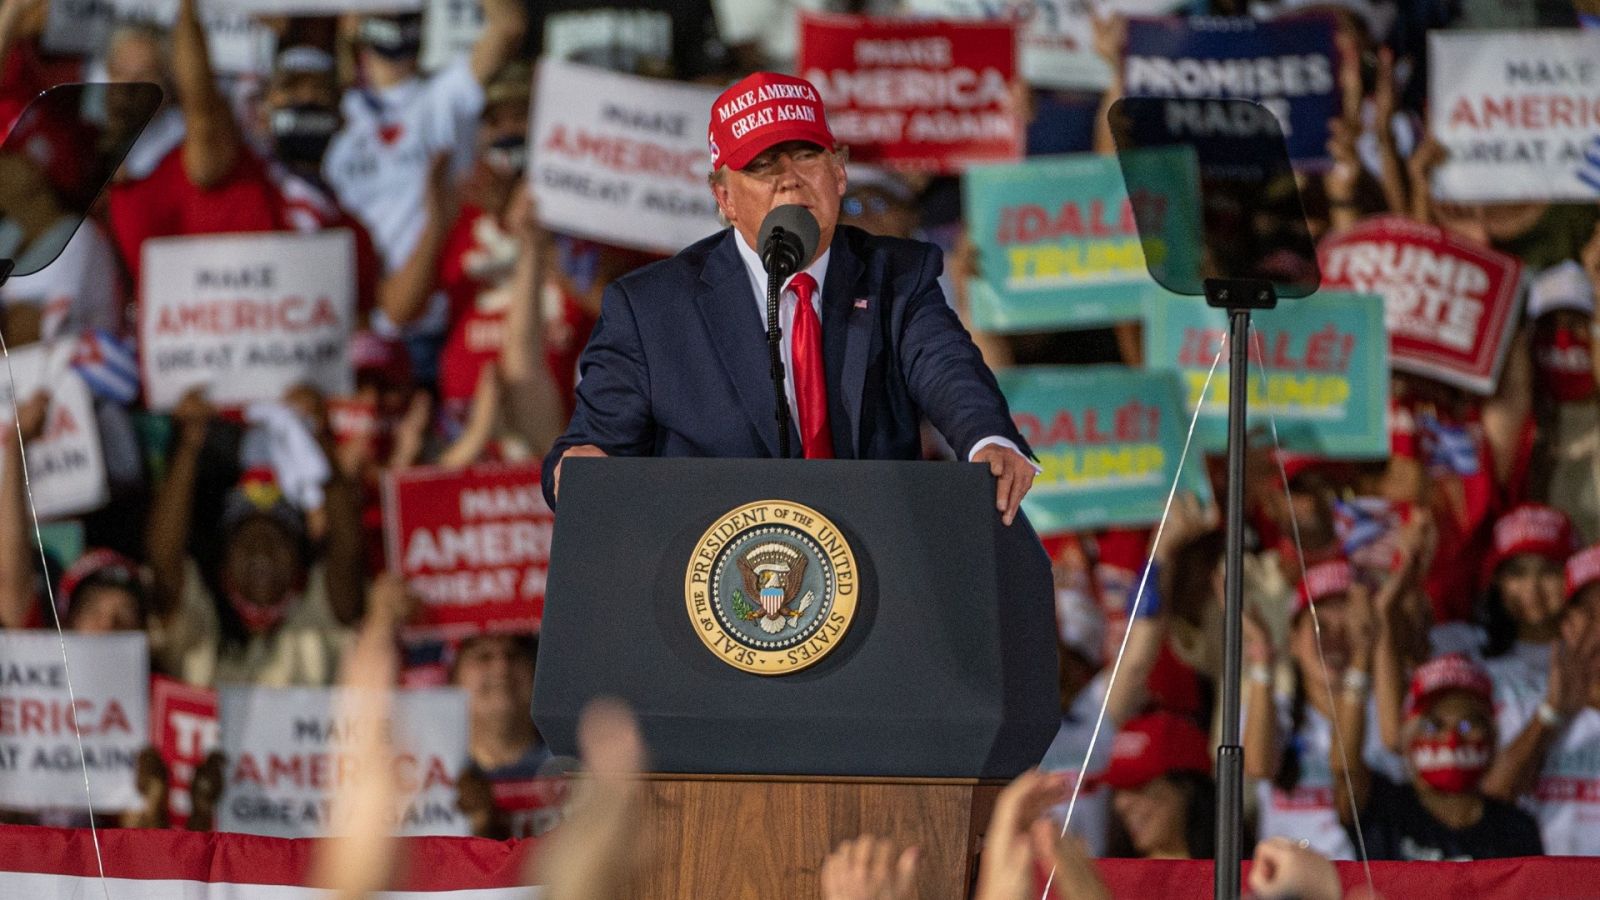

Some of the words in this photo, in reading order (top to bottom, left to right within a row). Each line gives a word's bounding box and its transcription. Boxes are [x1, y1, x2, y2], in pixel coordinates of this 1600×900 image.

[853, 37, 952, 68] MAKE
[1505, 59, 1592, 84] MAKE
[1126, 54, 1333, 97] PROMISES
[718, 90, 757, 123] MAKE
[758, 83, 817, 103] AMERICA
[731, 107, 775, 139] GREAT
[777, 104, 816, 123] AGAIN
[545, 123, 709, 187] AMERIC
[1324, 238, 1490, 296] TRUMP
[155, 295, 338, 336] AMERICA
[1032, 446, 1165, 486] RUMP
[774, 508, 790, 519] OF
[792, 511, 815, 529] THE
[692, 506, 769, 585] PRESIDENT
[816, 525, 854, 596] UNITED
[694, 590, 707, 615] THE
[700, 617, 715, 632] OF
[786, 612, 846, 665] STATES
[713, 636, 757, 666] SEAL
[0, 663, 64, 687] AKE
[0, 697, 133, 737] ERICA
